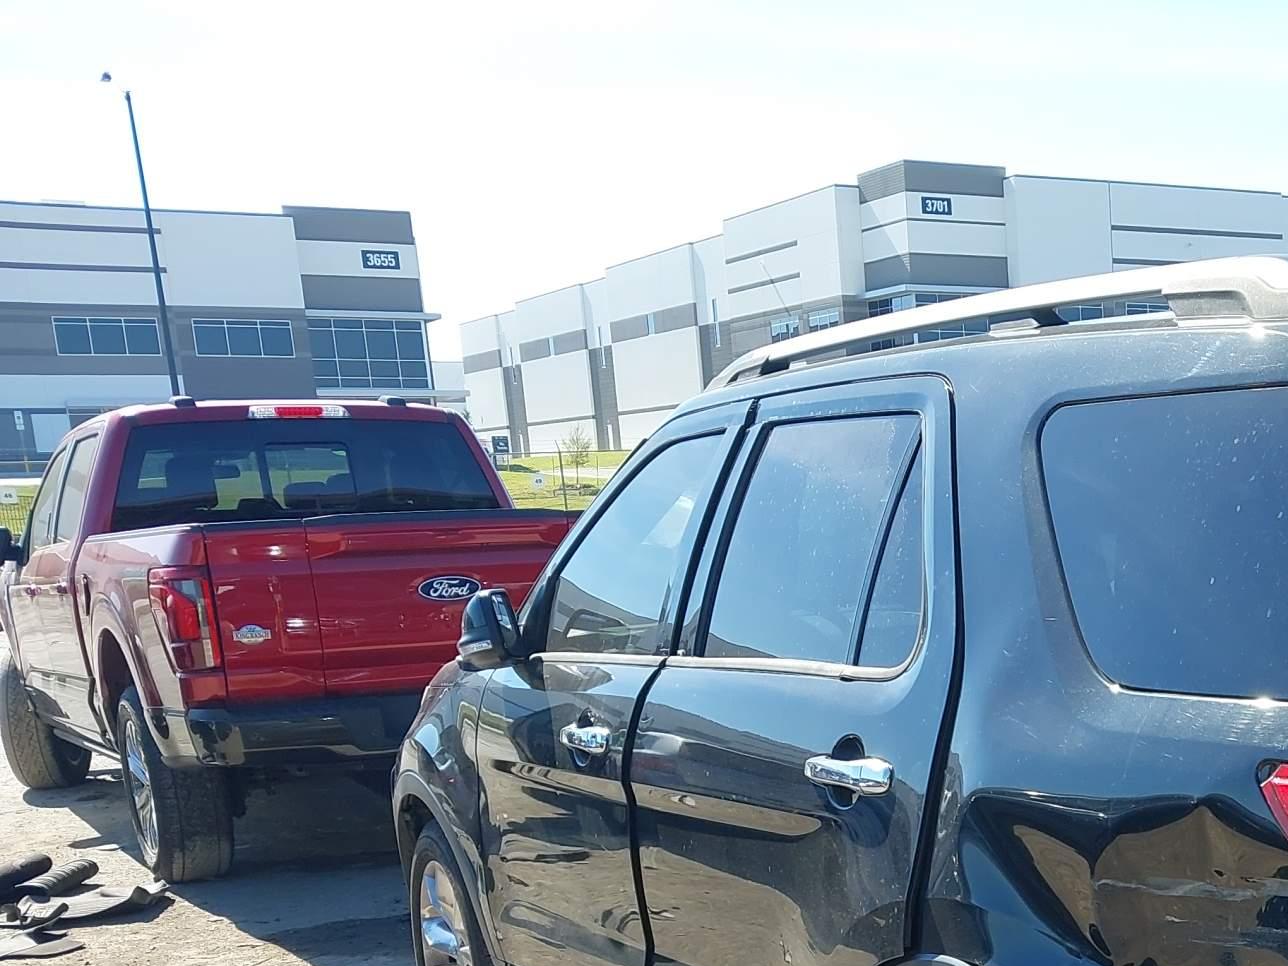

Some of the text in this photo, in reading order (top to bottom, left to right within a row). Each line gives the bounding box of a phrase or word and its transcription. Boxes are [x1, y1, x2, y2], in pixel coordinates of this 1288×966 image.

[926, 200, 948, 212] 3701
[366, 254, 396, 267] 3655
[430, 580, 470, 597] Ford
